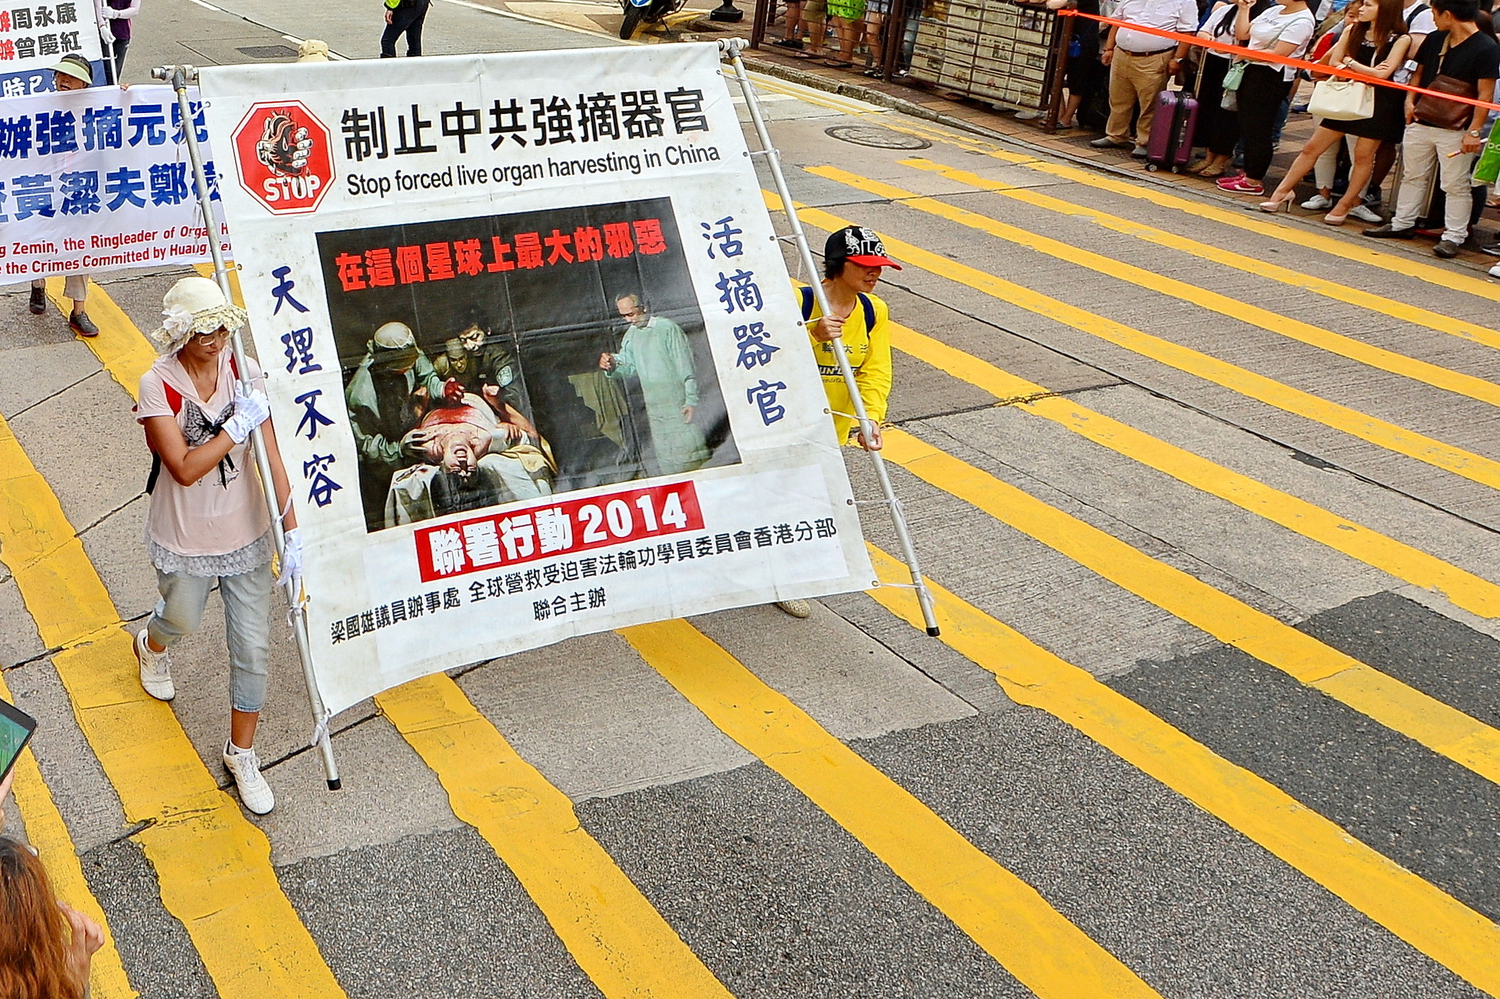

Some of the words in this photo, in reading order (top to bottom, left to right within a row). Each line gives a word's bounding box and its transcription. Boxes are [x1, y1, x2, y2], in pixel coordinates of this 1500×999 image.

[341, 87, 711, 163] 制止中共強摘器官
[264, 175, 321, 202] STOP
[347, 171, 392, 198] Stop
[394, 166, 454, 193] forced
[457, 164, 489, 186] live
[491, 164, 545, 191] organ
[548, 150, 641, 181] harvesting
[643, 149, 661, 168] in
[665, 142, 721, 167] China
[6, 262, 27, 276] the
[32, 258, 79, 273] Crimes
[82, 248, 150, 268] Committed
[153, 246, 166, 260] by
[170, 243, 207, 257] Huang
[12, 240, 58, 255] Zemin,
[63, 238, 85, 251] the
[90, 229, 158, 249] Ringleader
[163, 226, 176, 239] of
[180, 225, 209, 239] Orga
[334, 217, 668, 292] 在這個星球上最大的邪惡
[700, 216, 787, 426] 活摘器官
[271, 266, 342, 508] 天理不容
[428, 505, 572, 576] 聯署行動
[582, 492, 688, 543] 2014
[330, 587, 461, 646] 梁國雄議員辦事處
[468, 516, 837, 602] 全球營救受迫害法輪功學員委員會香港分部
[533, 587, 607, 622] 聯合主辦
